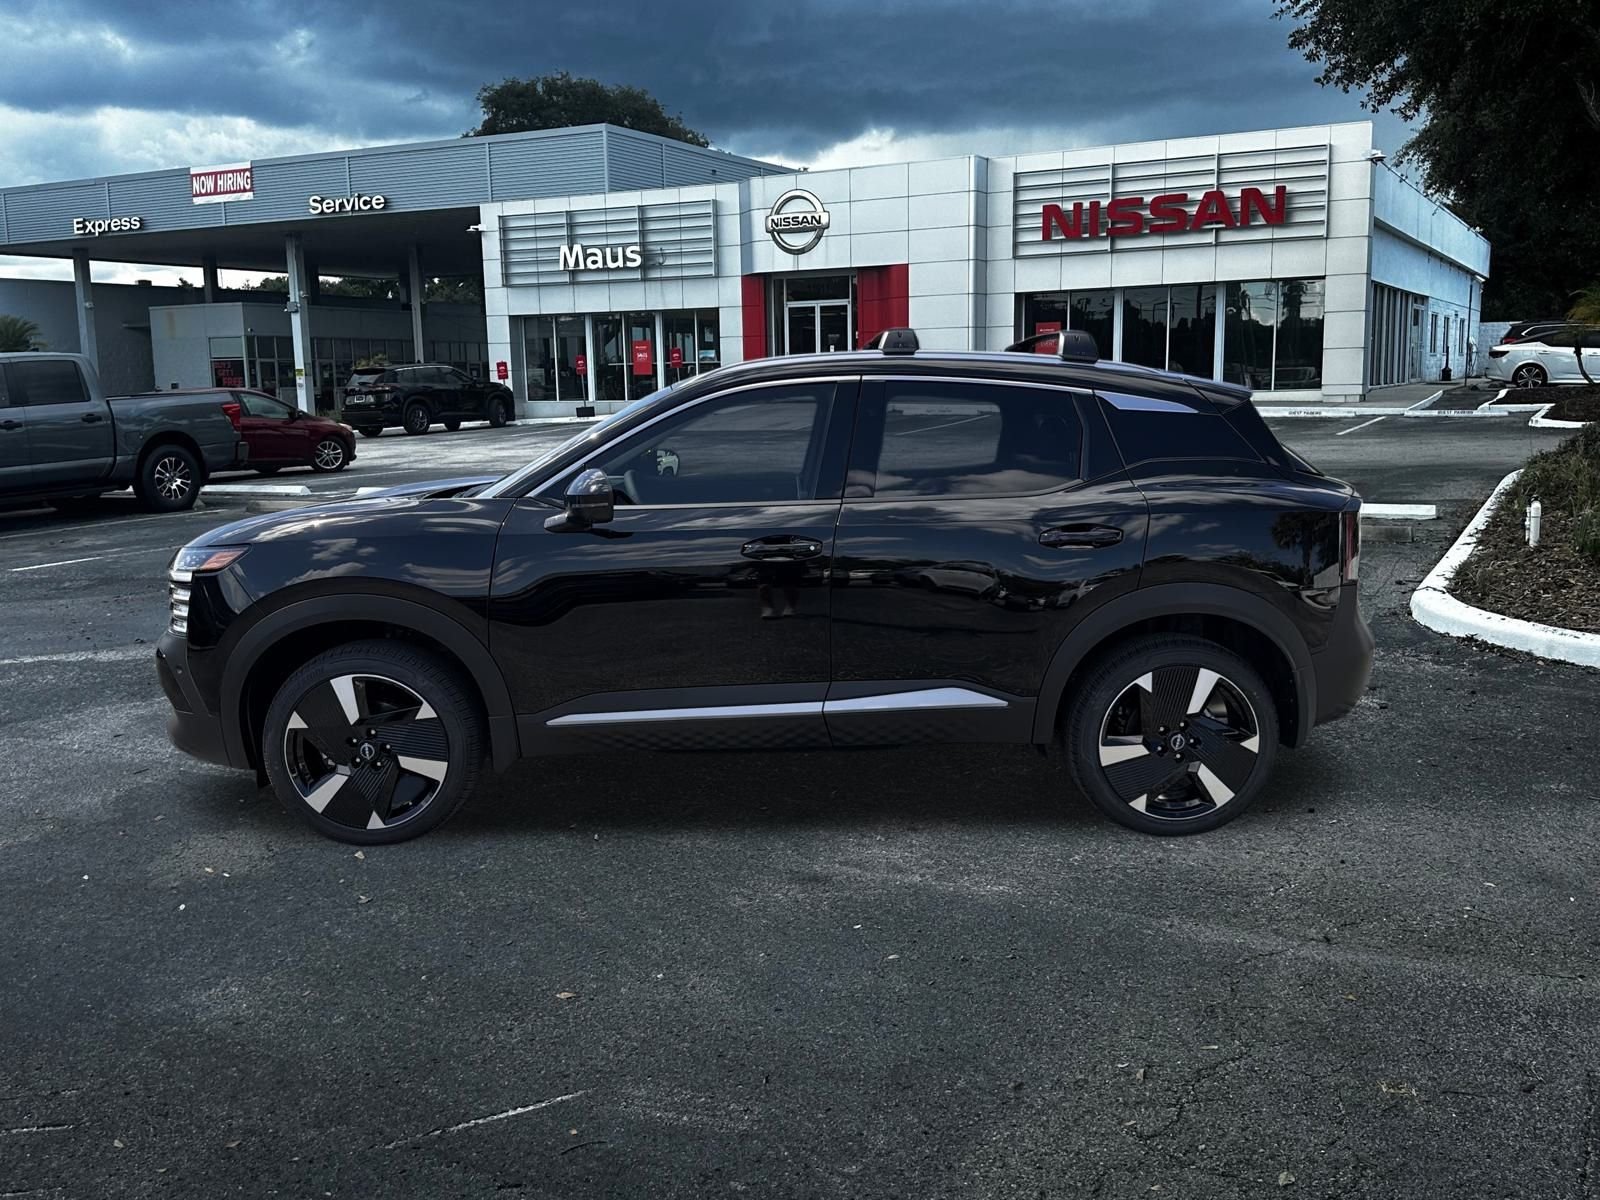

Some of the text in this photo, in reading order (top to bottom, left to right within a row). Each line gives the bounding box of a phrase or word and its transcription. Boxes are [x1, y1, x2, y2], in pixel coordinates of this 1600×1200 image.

[192, 171, 251, 195] NOW HIRING
[308, 193, 386, 215] Service
[1042, 185, 1287, 241] NISSAN
[73, 216, 141, 237] Express
[770, 215, 821, 228] NISSAN
[559, 244, 642, 270] Maus
